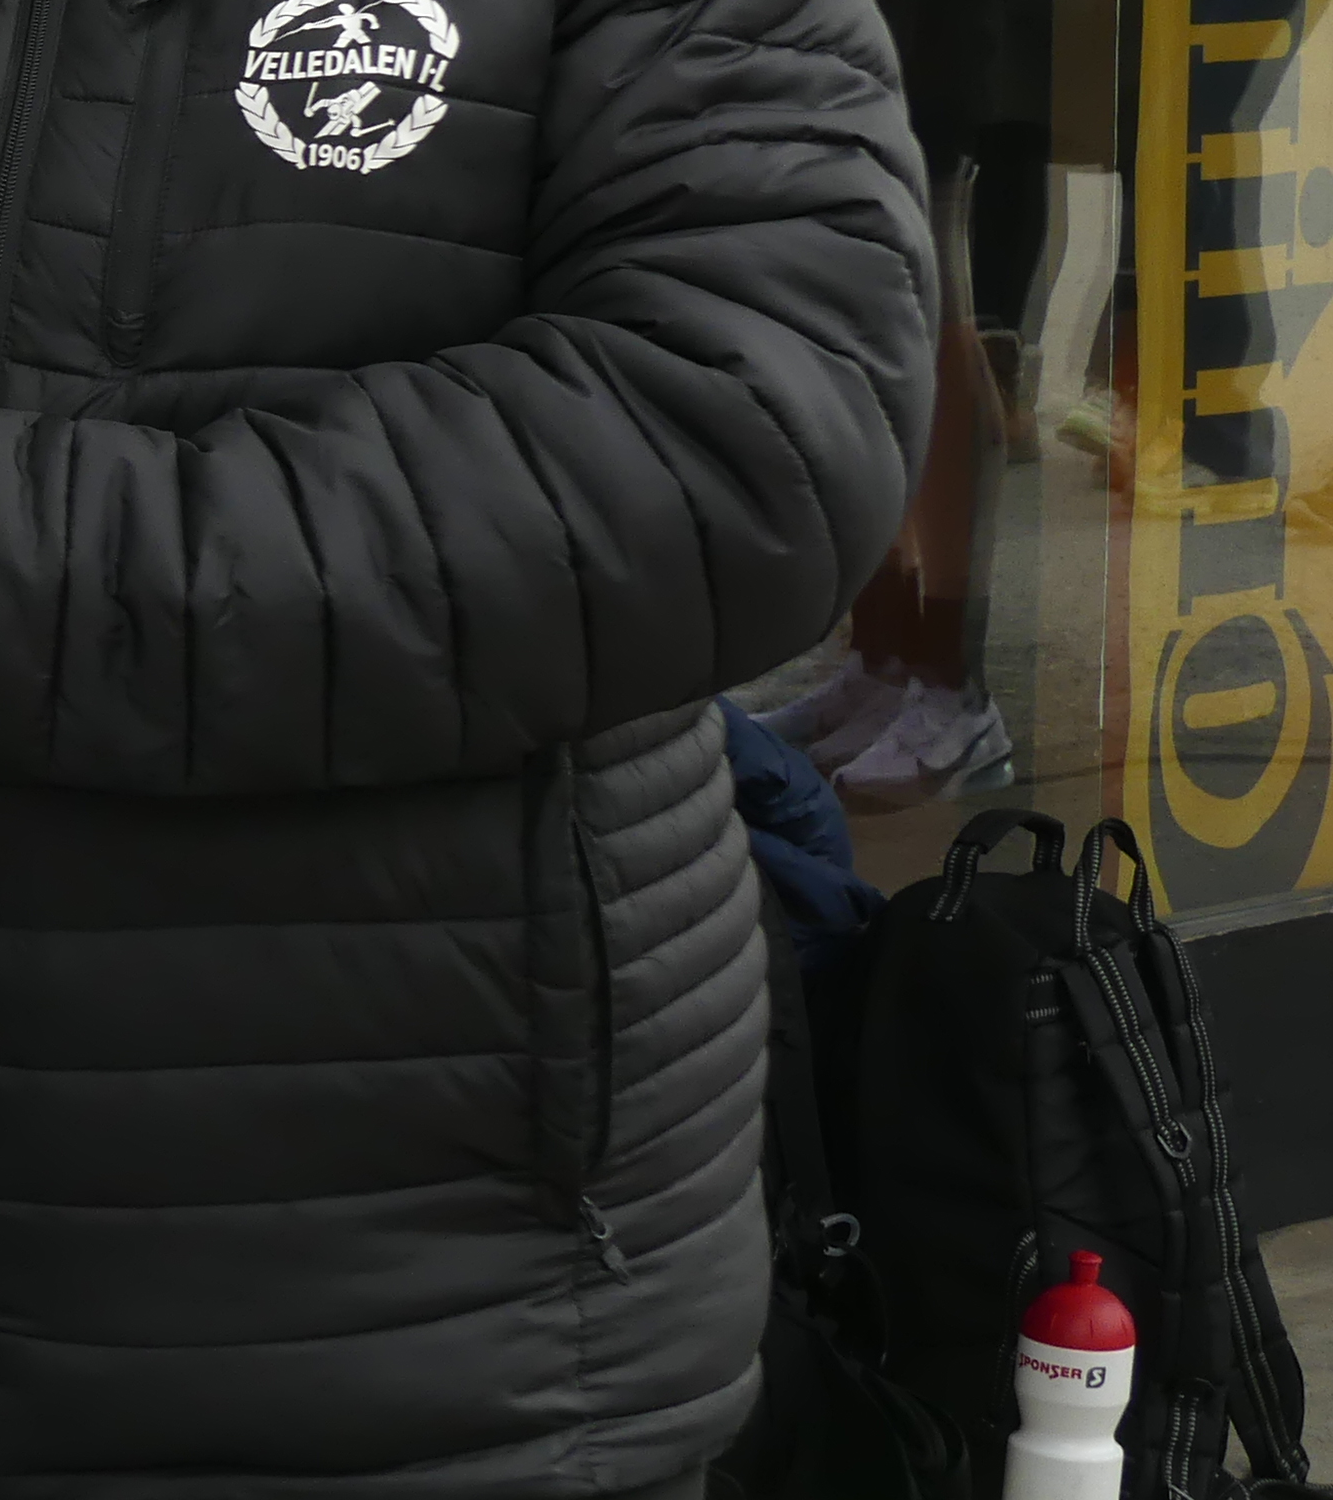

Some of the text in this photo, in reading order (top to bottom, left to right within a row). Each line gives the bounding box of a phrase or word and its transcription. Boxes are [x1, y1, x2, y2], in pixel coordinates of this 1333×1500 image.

[243, 44, 418, 80] VELLEDALEN
[307, 143, 363, 171] 1906
[1018, 1352, 1083, 1380] SPONSER
